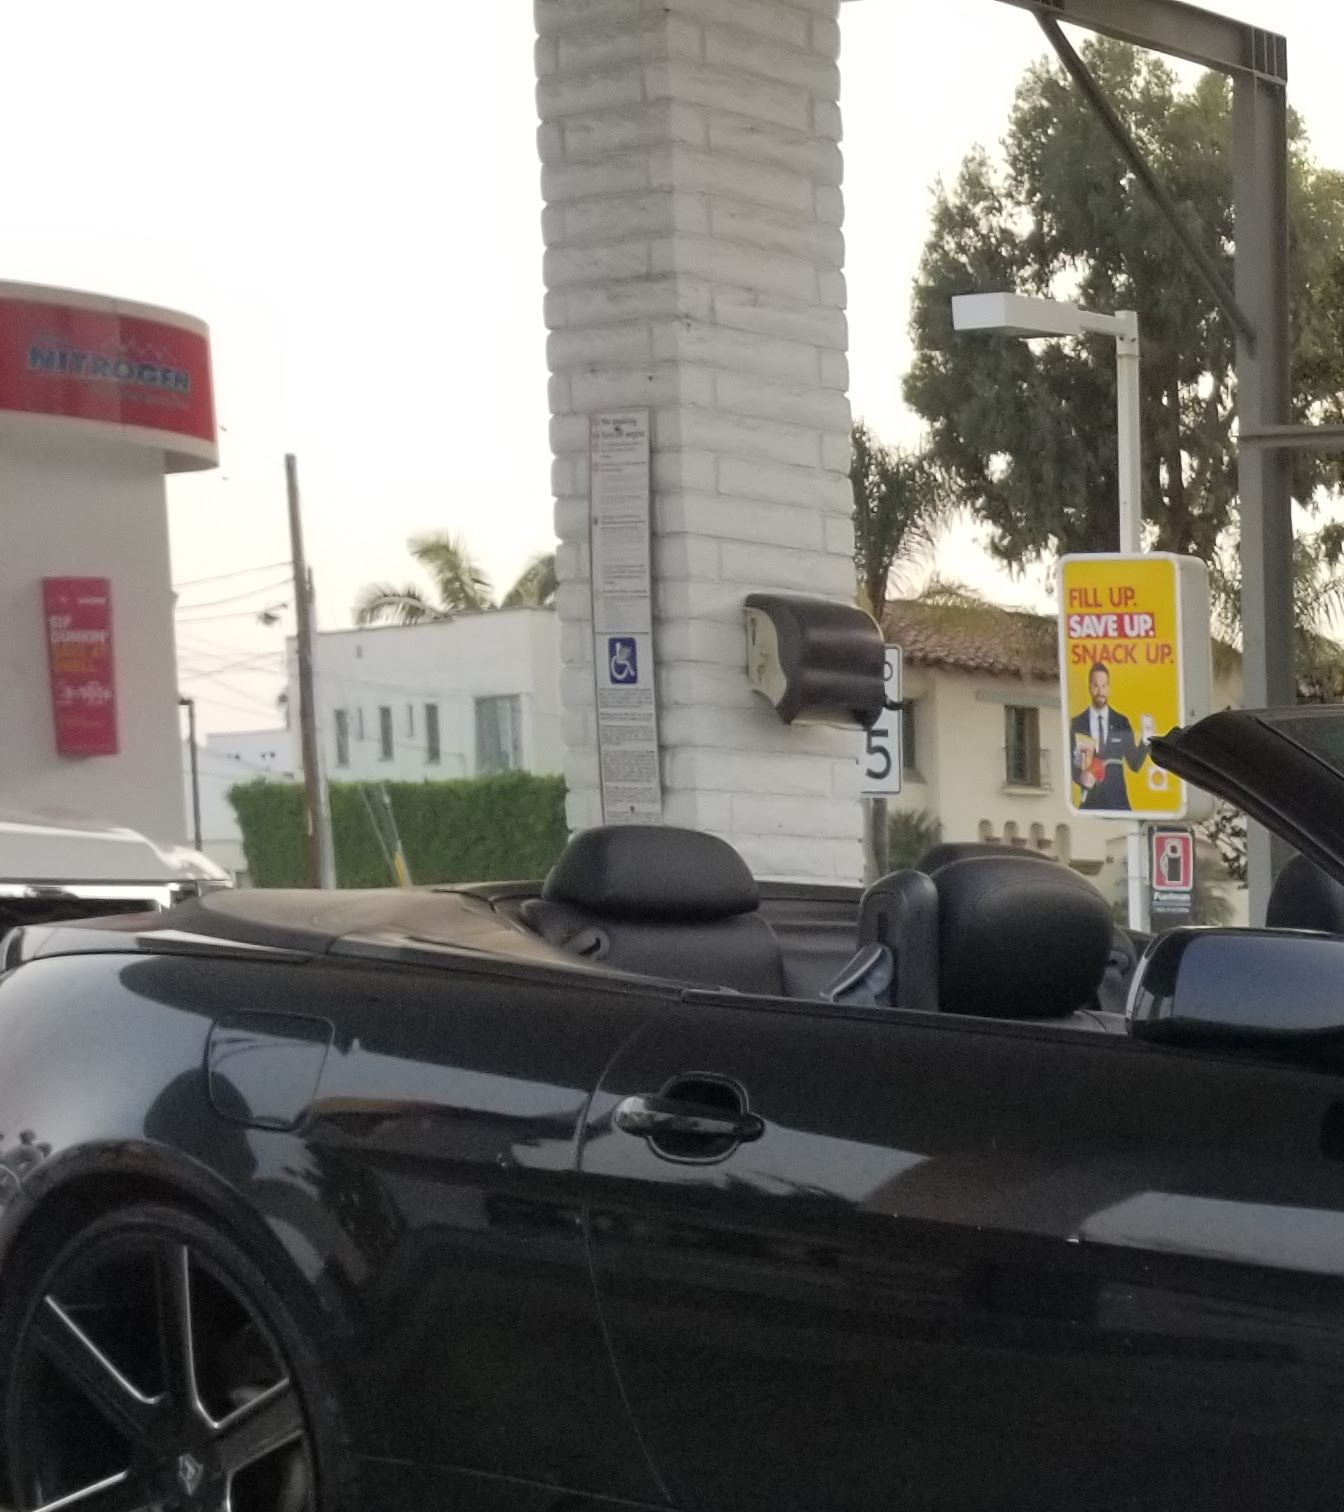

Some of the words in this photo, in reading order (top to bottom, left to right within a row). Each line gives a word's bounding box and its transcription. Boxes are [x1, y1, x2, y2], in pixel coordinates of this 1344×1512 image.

[1069, 587, 1102, 608] FILL
[1109, 586, 1137, 608] UP.
[1069, 614, 1118, 637] SAVE
[1123, 613, 1154, 637] UP.
[1072, 643, 1137, 664] SNACK
[1146, 643, 1174, 664] UP.
[866, 729, 892, 780] 5
